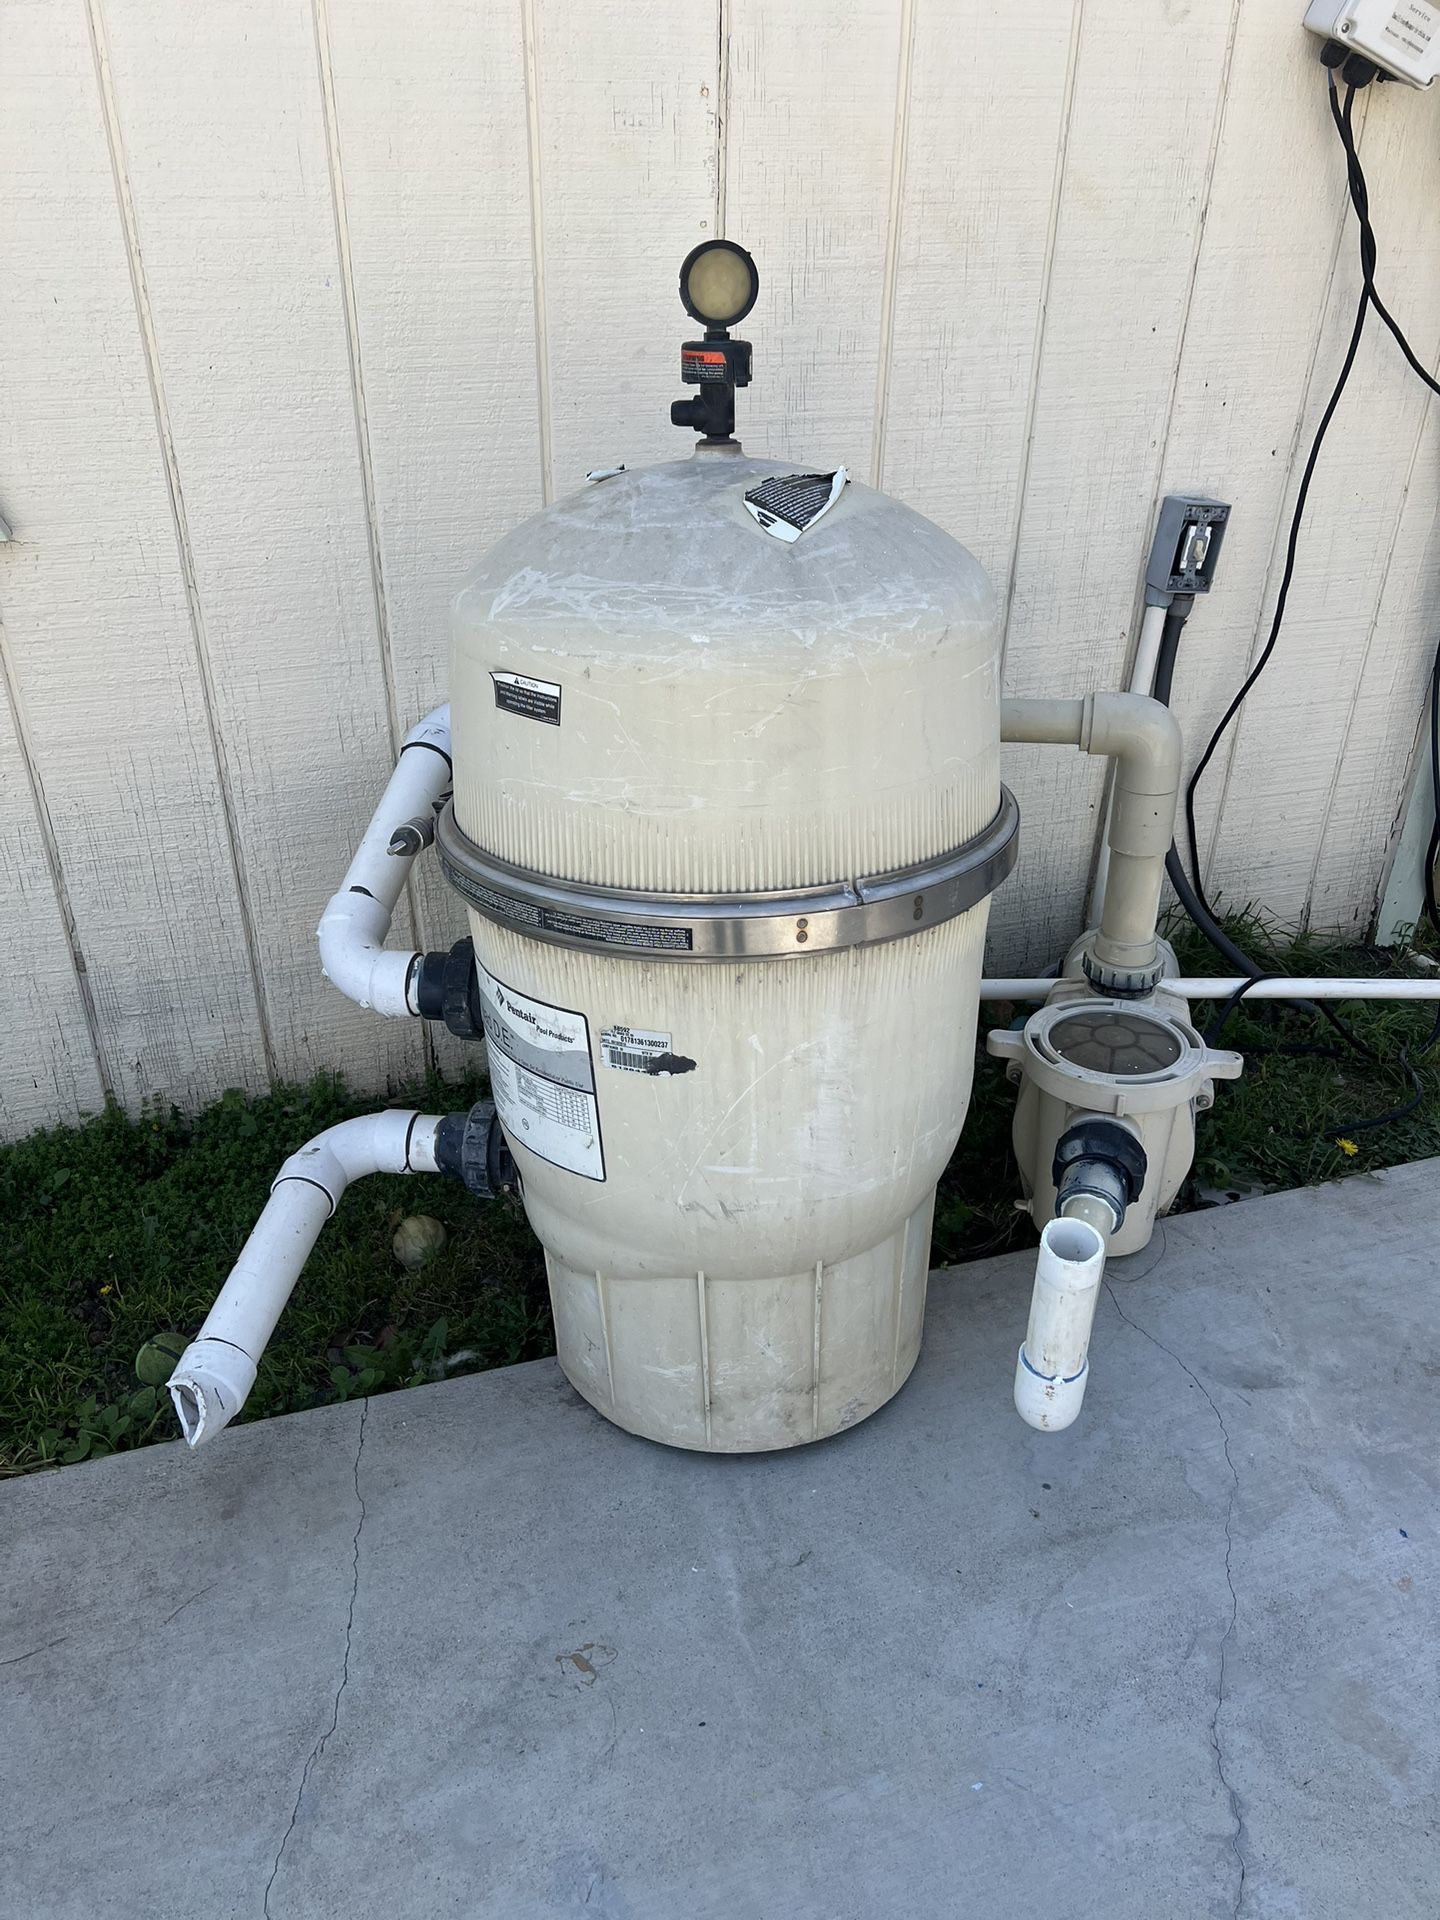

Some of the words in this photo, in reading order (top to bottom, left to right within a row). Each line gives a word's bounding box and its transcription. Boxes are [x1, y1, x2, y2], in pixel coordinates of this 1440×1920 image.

[519, 679, 539, 689] CAUTION
[506, 1000, 537, 1025] Pentair
[536, 1025, 548, 1036] Pool
